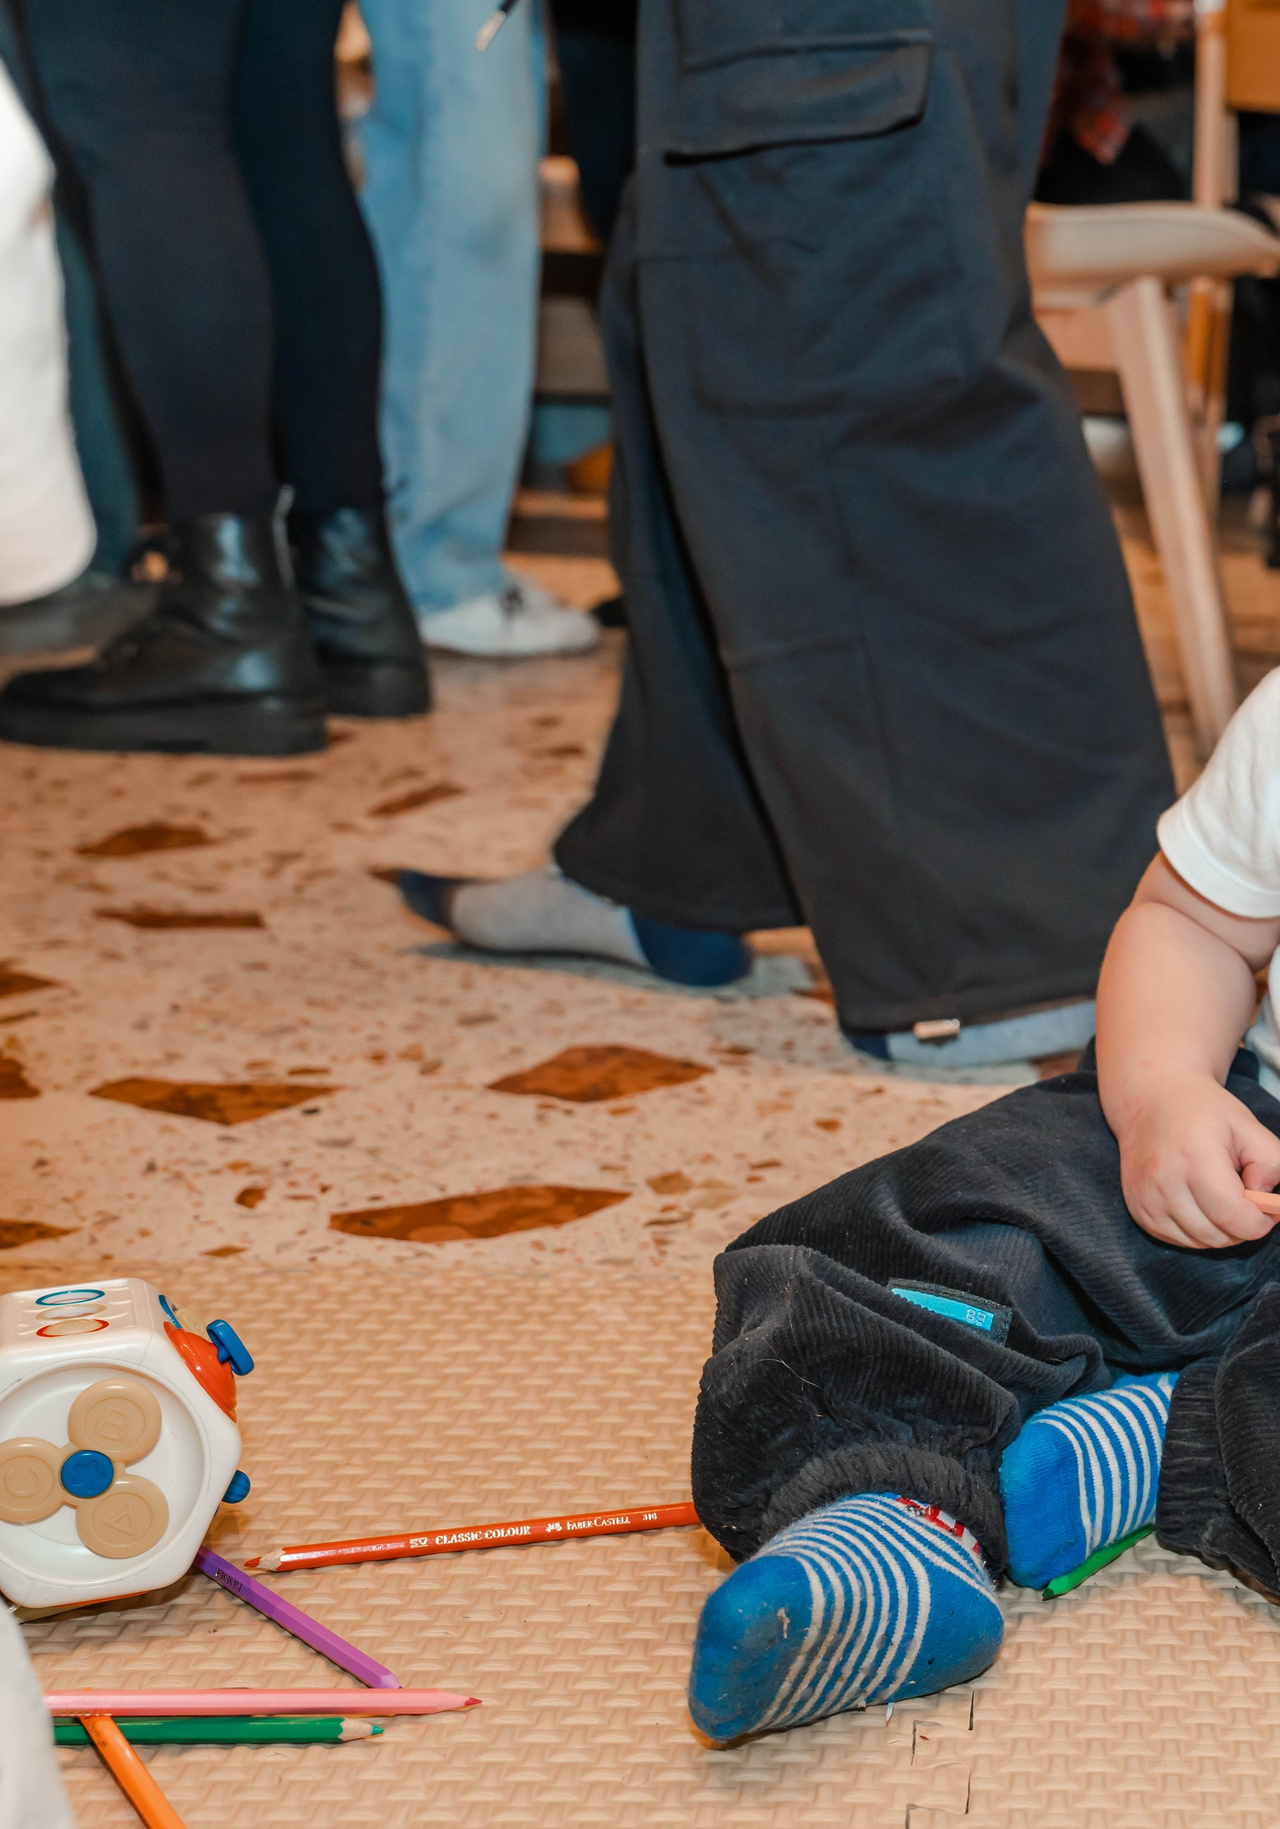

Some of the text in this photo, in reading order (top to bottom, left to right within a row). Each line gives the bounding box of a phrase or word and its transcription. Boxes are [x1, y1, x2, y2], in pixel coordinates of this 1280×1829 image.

[95, 1406, 132, 1441] B
[435, 1531, 482, 1545] CLASSIC
[484, 1525, 531, 1539] COLOUR
